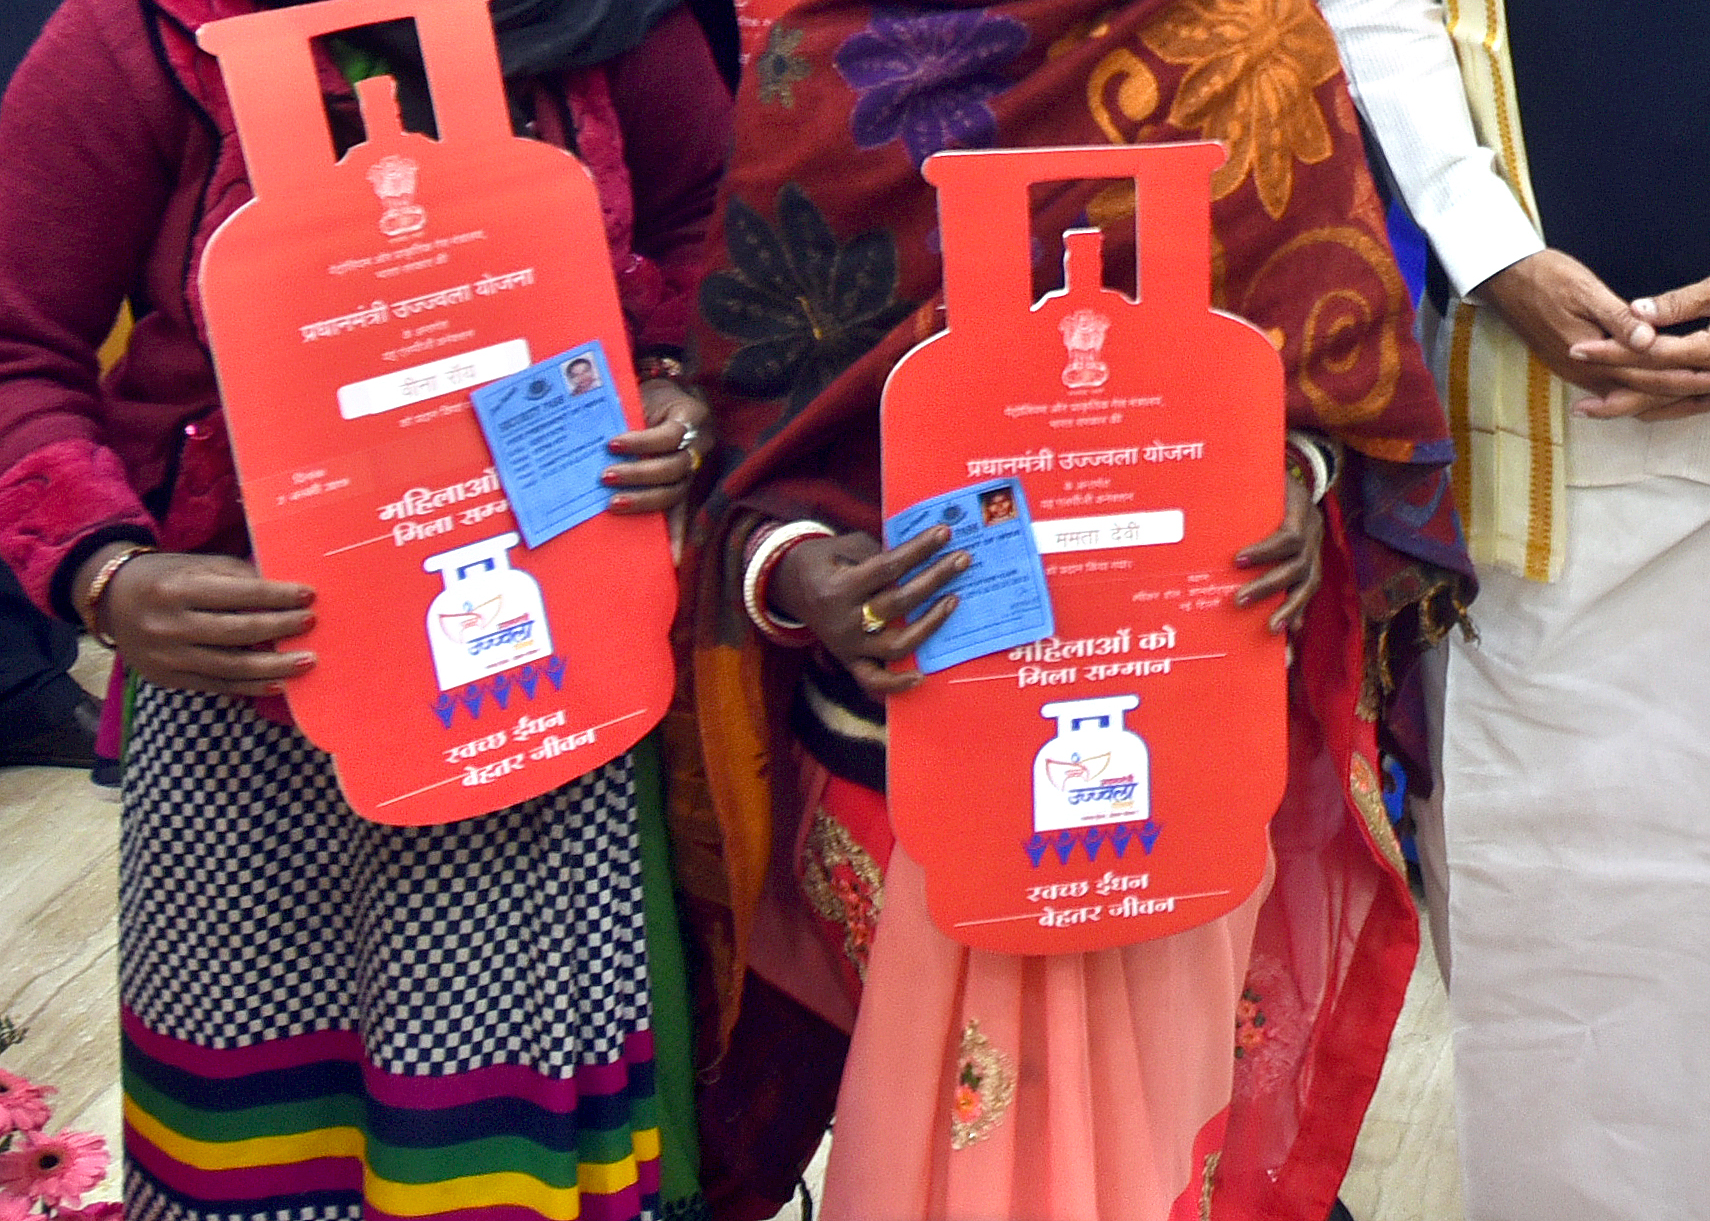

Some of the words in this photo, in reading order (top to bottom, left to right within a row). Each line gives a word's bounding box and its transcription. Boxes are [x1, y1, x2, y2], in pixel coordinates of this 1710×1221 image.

[298, 299, 388, 342] प्रधानमंत्री
[389, 283, 471, 318] उज्ज्वला
[472, 267, 534, 295] योजना
[966, 447, 1054, 477] प्रधानमंत्री
[1057, 446, 1139, 469] उज्ज्वला
[1142, 440, 1204, 462] योजना
[391, 515, 453, 547] मिला
[1054, 528, 1100, 547] ममता
[1110, 520, 1140, 541] देवी
[1005, 626, 1134, 666] महिलाओं
[1136, 622, 1177, 652] को
[1016, 665, 1077, 688] मिला
[1084, 657, 1173, 680] सम्मान
[443, 730, 507, 764] स्वच्छ
[512, 709, 566, 741] ईंधन
[458, 752, 524, 786] बेहतर
[529, 727, 596, 760] जीवन
[1026, 880, 1089, 902] स्वच्छ
[1095, 870, 1149, 895] ईंधन
[1036, 904, 1102, 927] बेहतर
[1108, 895, 1175, 917] जीवन
